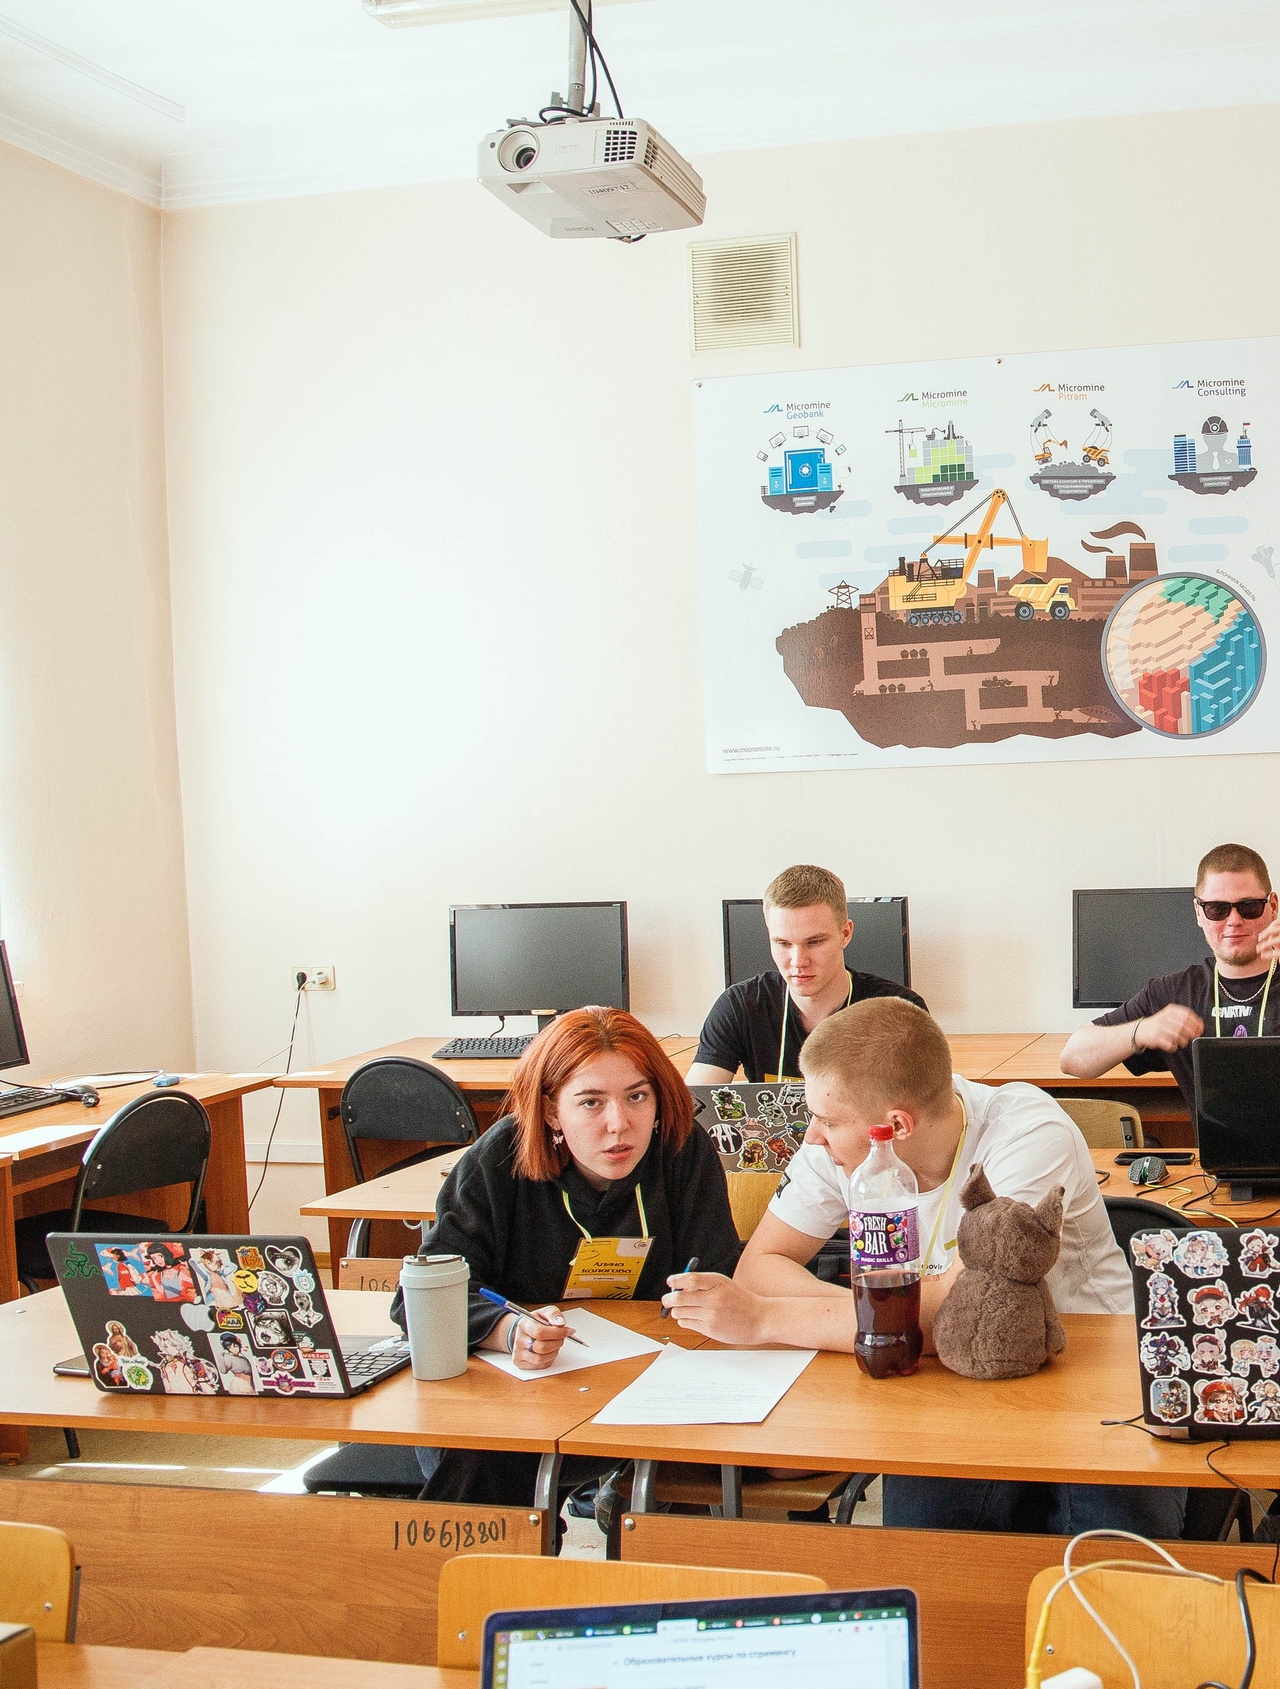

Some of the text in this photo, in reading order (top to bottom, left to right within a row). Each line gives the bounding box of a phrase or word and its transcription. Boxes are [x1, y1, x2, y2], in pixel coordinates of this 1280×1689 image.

[1058, 383, 1105, 392] Micromine
[1197, 378, 1245, 388] Micromine
[921, 389, 968, 400] Micromine
[1058, 392, 1088, 400] Pitram
[1197, 387, 1246, 397] Consulting
[786, 401, 831, 411] Micromine
[921, 398, 968, 408] Micromine
[786, 410, 825, 420] Geobank
[1215, 568, 1240, 585] БЛОЧНАЯ
[722, 745, 781, 754] www.micromine.ru
[863, 1215, 887, 1231] FRESH
[864, 1231, 889, 1255] BAR
[394, 1518, 506, 1552] 106618801
[623, 1654, 704, 1666] Образовательные
[706, 1652, 734, 1663] курсы
[735, 1651, 747, 1659] по
